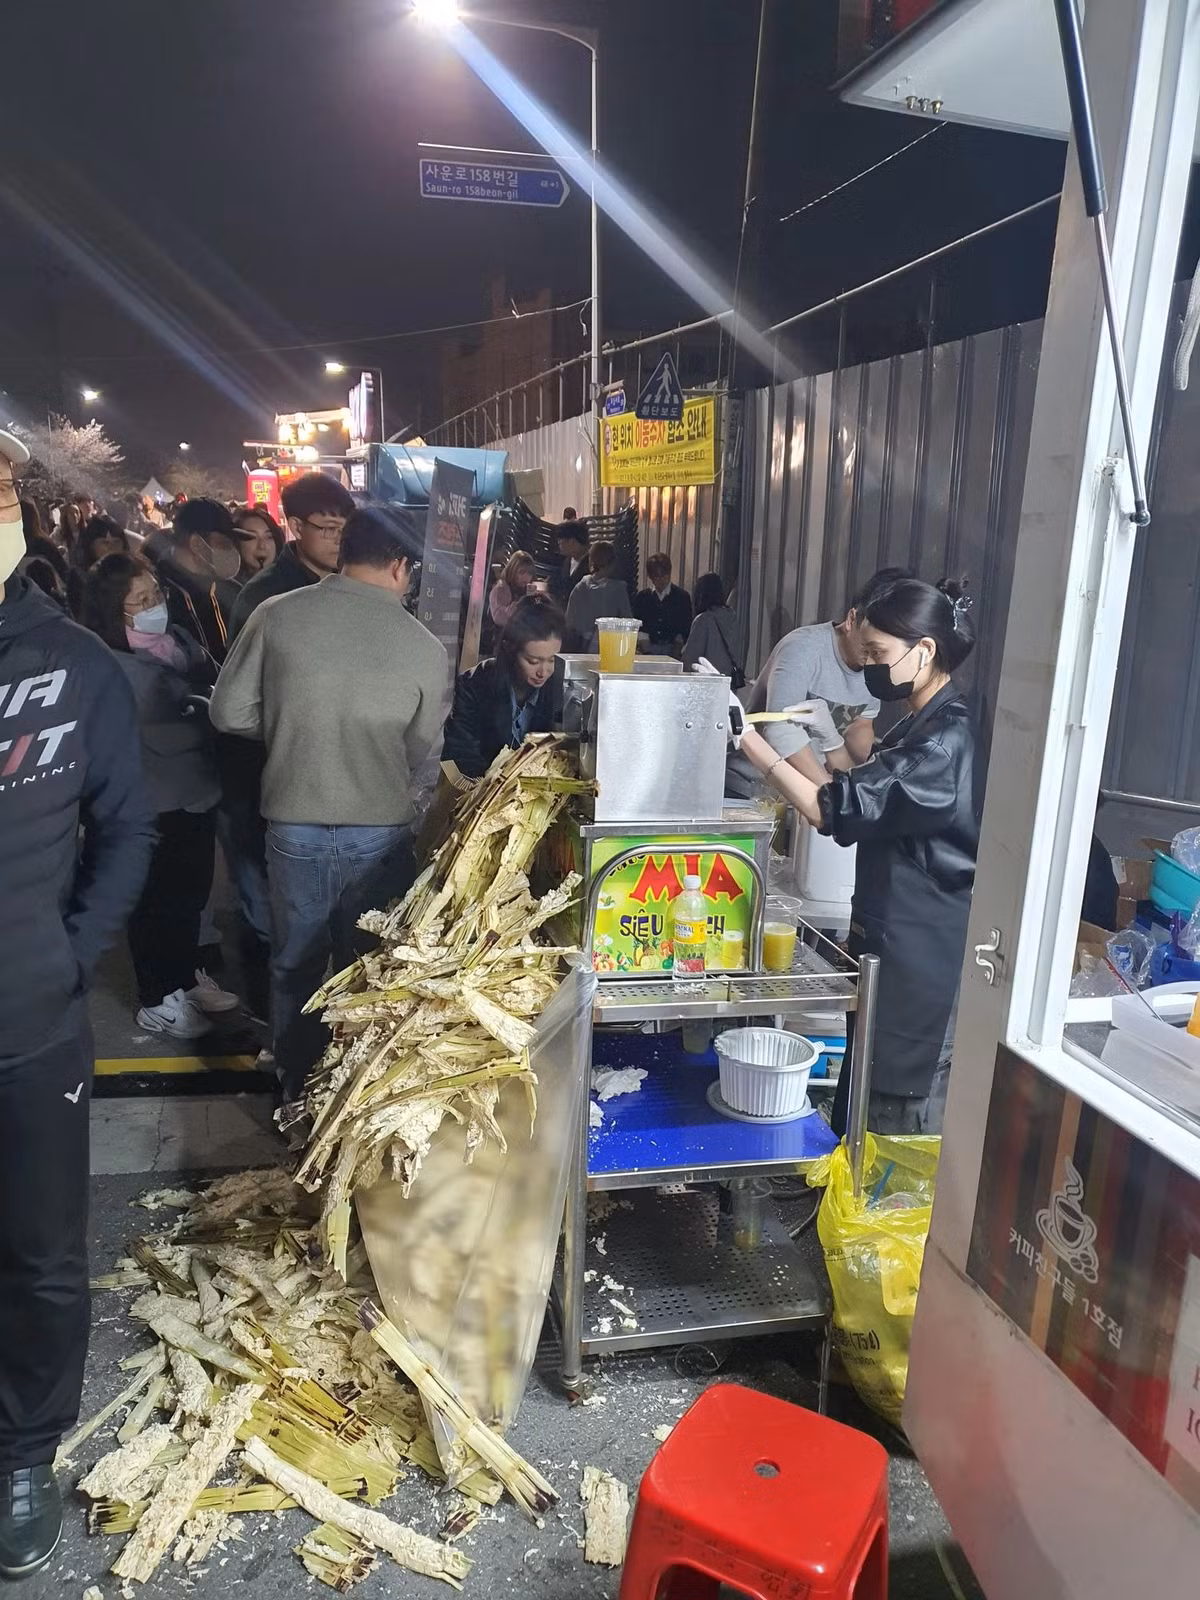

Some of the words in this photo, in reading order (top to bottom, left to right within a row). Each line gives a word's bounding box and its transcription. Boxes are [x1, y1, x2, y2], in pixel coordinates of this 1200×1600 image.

[425, 164, 519, 187] 사운로158번길
[425, 182, 462, 195] Saun-ro
[465, 185, 519, 200] 158beon-gil
[612, 423, 619, 451] 현
[620, 421, 634, 450] 위치
[687, 405, 707, 441] 안내
[0, 669, 67, 718] A
[628, 852, 745, 904] MIA
[1009, 1226, 1076, 1306] 커피친구들
[1082, 1297, 1124, 1351] 1호점
